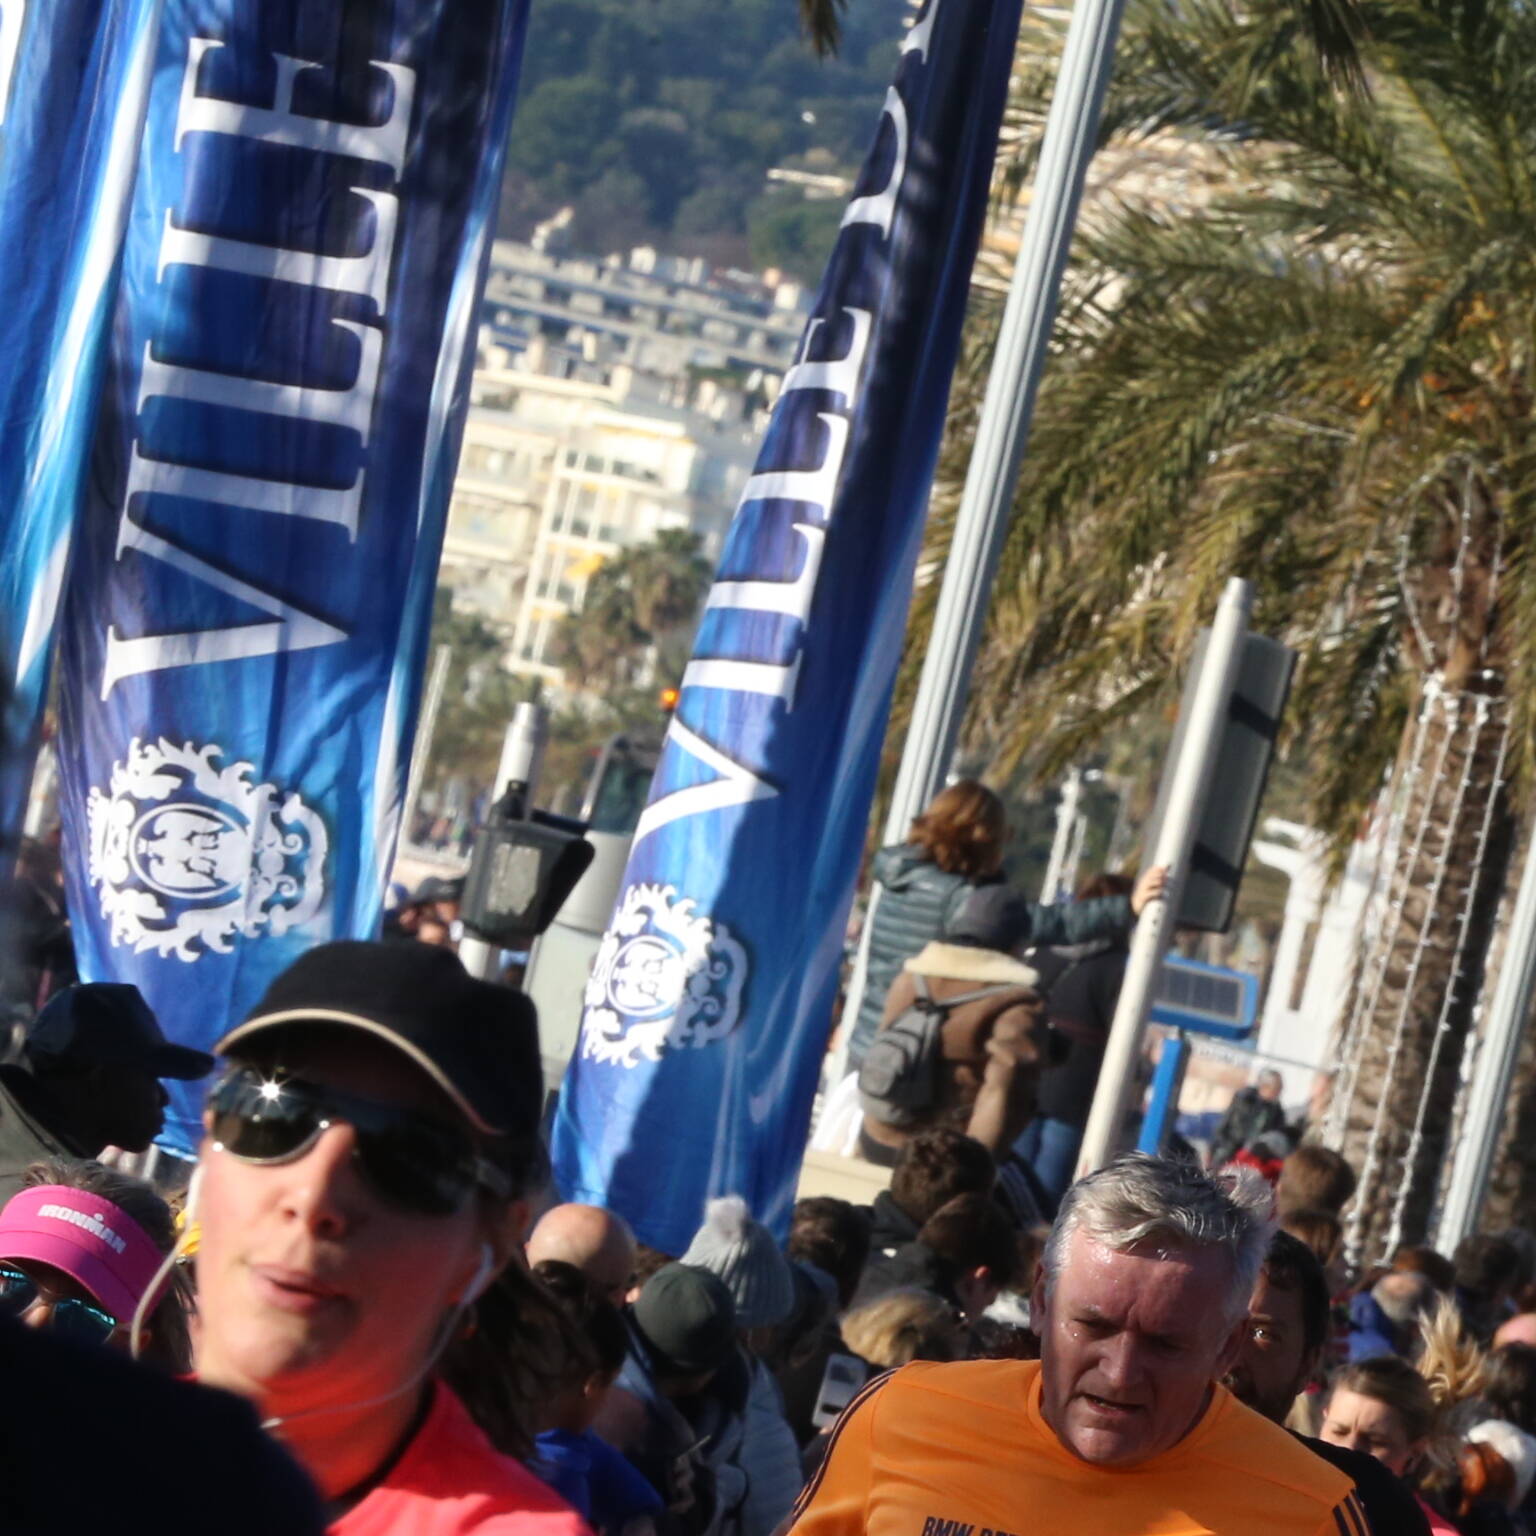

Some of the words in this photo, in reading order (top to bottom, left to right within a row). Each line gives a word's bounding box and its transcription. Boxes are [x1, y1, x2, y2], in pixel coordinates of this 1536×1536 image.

[101, 37, 417, 701] VILLE
[630, 305, 873, 851] VILLE
[37, 1203, 127, 1255] IRONMAN
